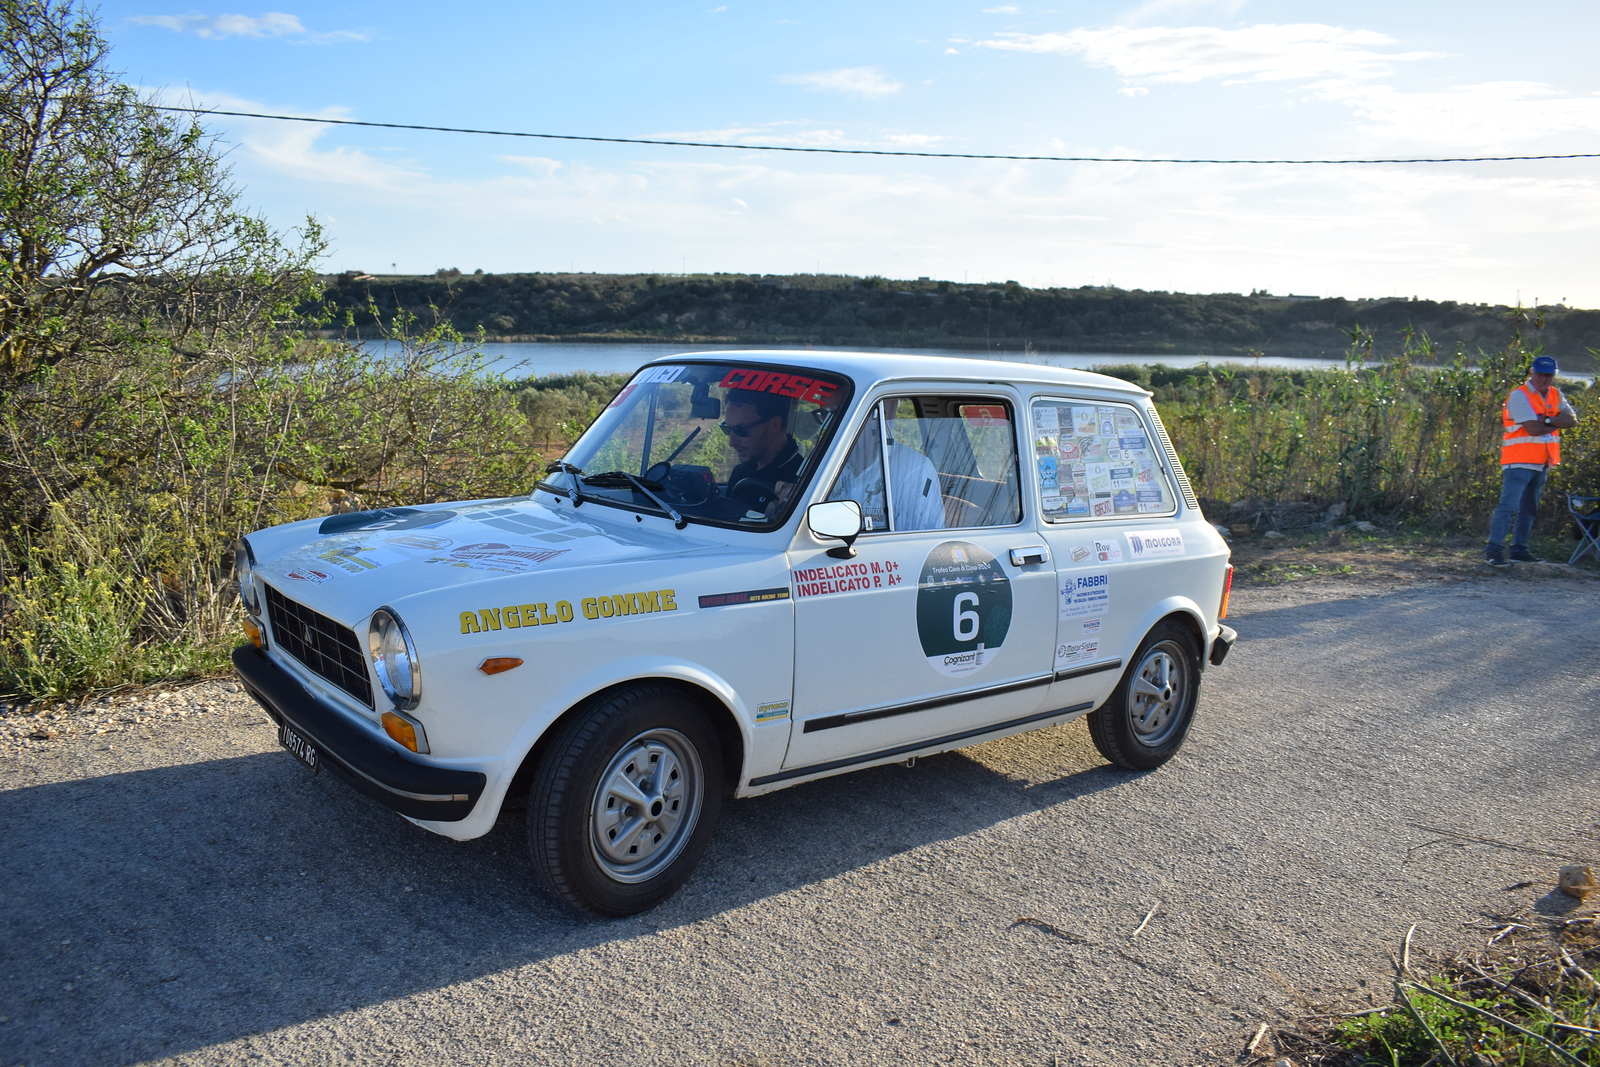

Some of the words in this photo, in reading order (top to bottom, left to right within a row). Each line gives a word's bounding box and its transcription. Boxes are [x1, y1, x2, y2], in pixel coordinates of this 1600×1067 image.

[719, 368, 838, 406] CORSE
[1145, 536, 1182, 549] MOLGORA
[794, 565, 868, 583] INDELICATO
[871, 562, 884, 575] M.
[1077, 575, 1108, 588] FABBRI
[796, 576, 871, 597] INDELICATO
[888, 574, 902, 586] A+
[459, 599, 574, 634] ANGELO
[581, 589, 678, 620] GOMME
[953, 591, 980, 642] 6
[944, 652, 976, 667] Cognizant
[305, 745, 316, 766] RG
